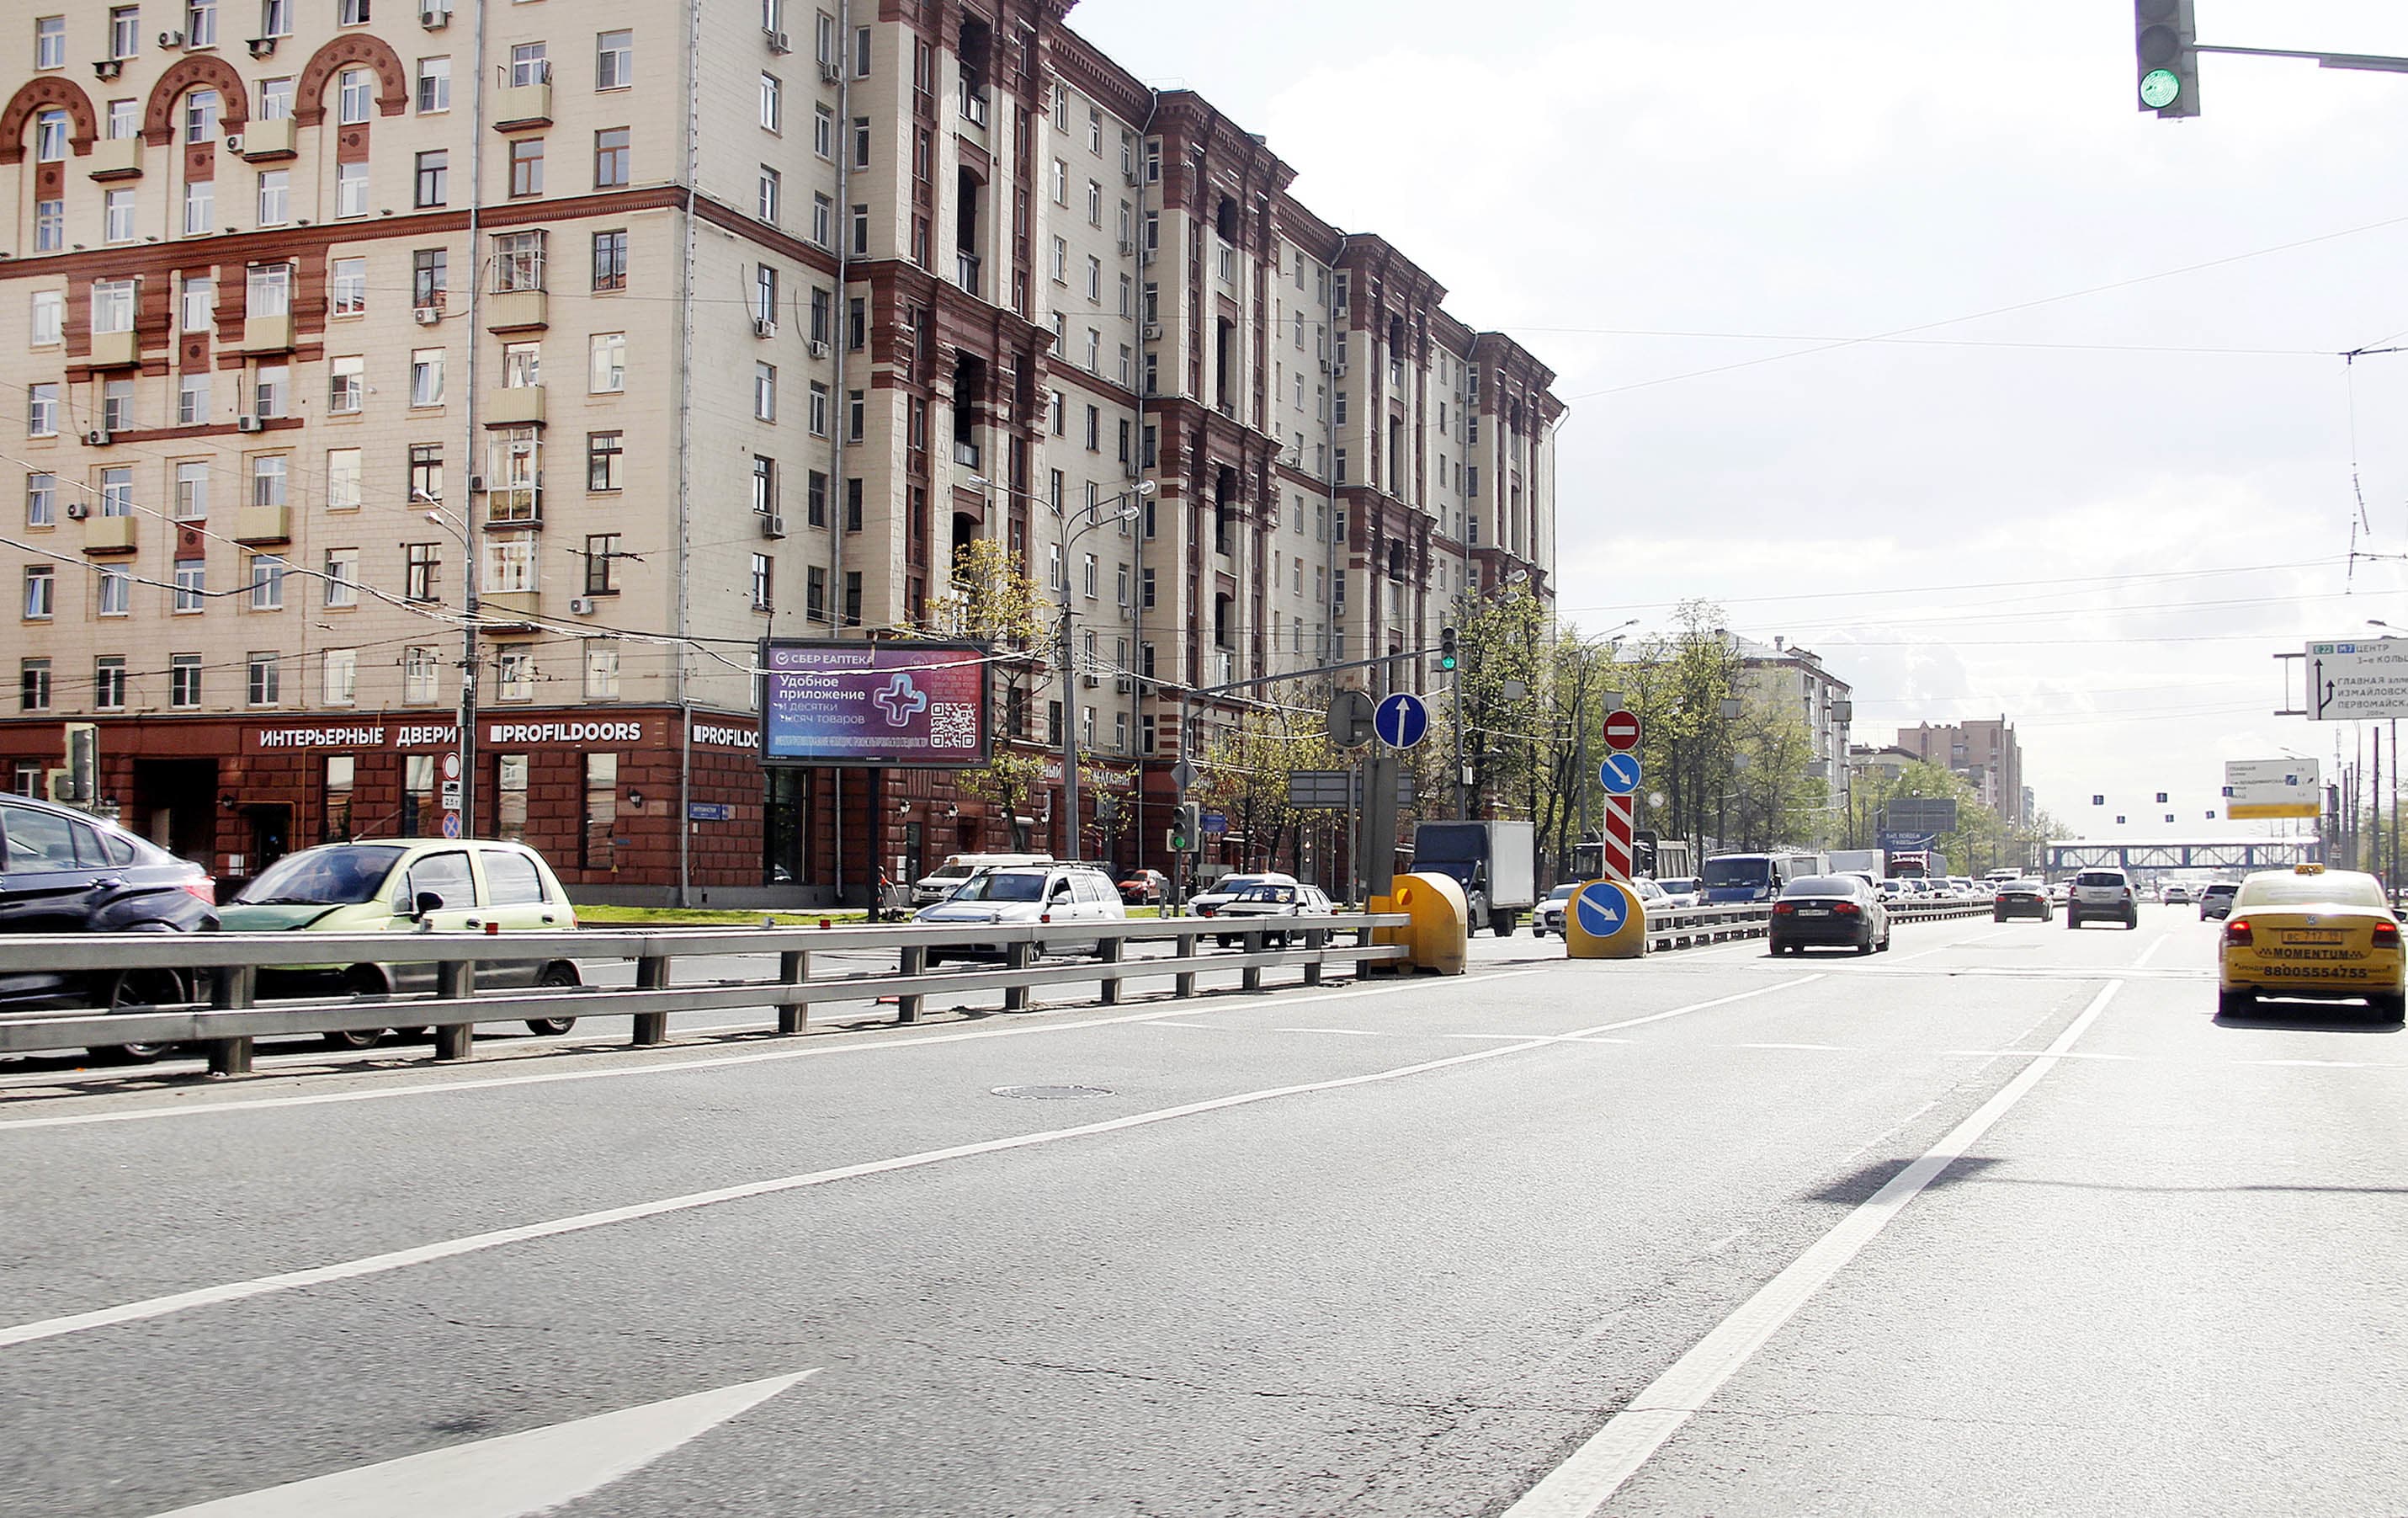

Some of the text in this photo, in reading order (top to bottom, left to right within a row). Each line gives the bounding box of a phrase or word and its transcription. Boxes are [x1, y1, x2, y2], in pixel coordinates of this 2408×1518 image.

[2357, 644, 2389, 653] ЦЕНТР
[791, 654, 874, 665] СБЕР ЕАПТЕКА
[779, 675, 839, 688] Удобное
[2337, 676, 2384, 685] ГЛАВНАЯ
[779, 690, 866, 701] приложение
[789, 702, 838, 712] десятки
[2337, 699, 2408, 709] ПЕРВОМАЙСК
[780, 714, 865, 725] ысяч товаров
[260, 727, 457, 747] ИНТЕРЬЕРНЫЕ ДВЕРИ
[502, 722, 642, 742] PROFILDOORS
[2273, 948, 2349, 960] MOMENTUM
[2263, 966, 2368, 978] 88005554755
